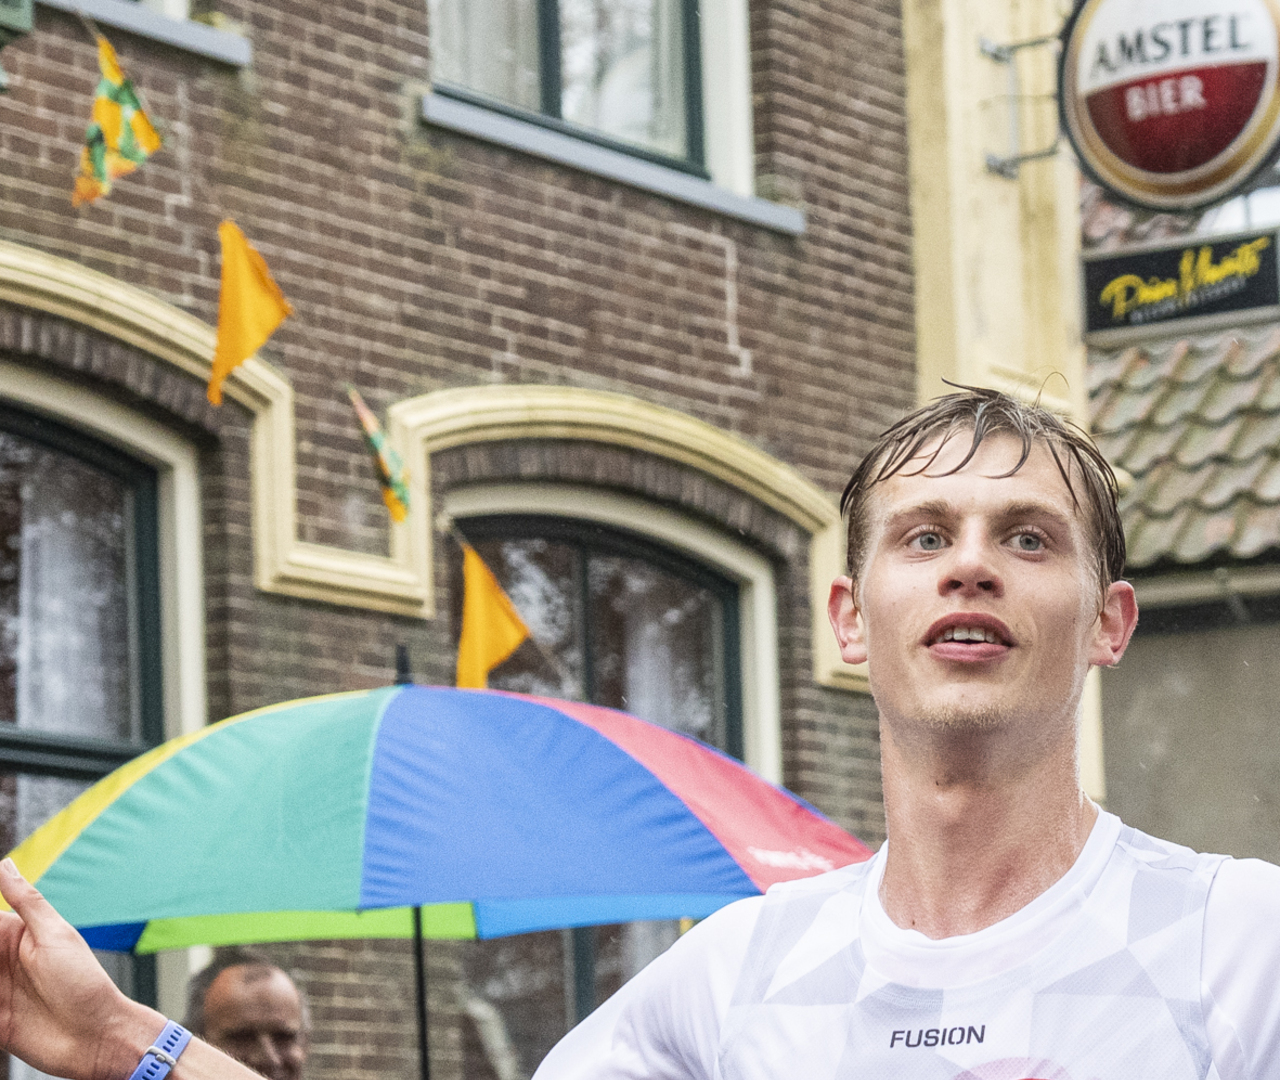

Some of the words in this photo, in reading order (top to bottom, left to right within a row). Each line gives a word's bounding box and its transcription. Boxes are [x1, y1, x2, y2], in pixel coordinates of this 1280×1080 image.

[1088, 12, 1251, 80] AMSTEL
[1124, 75, 1206, 122] BIER
[889, 1025, 986, 1048] FUSION
